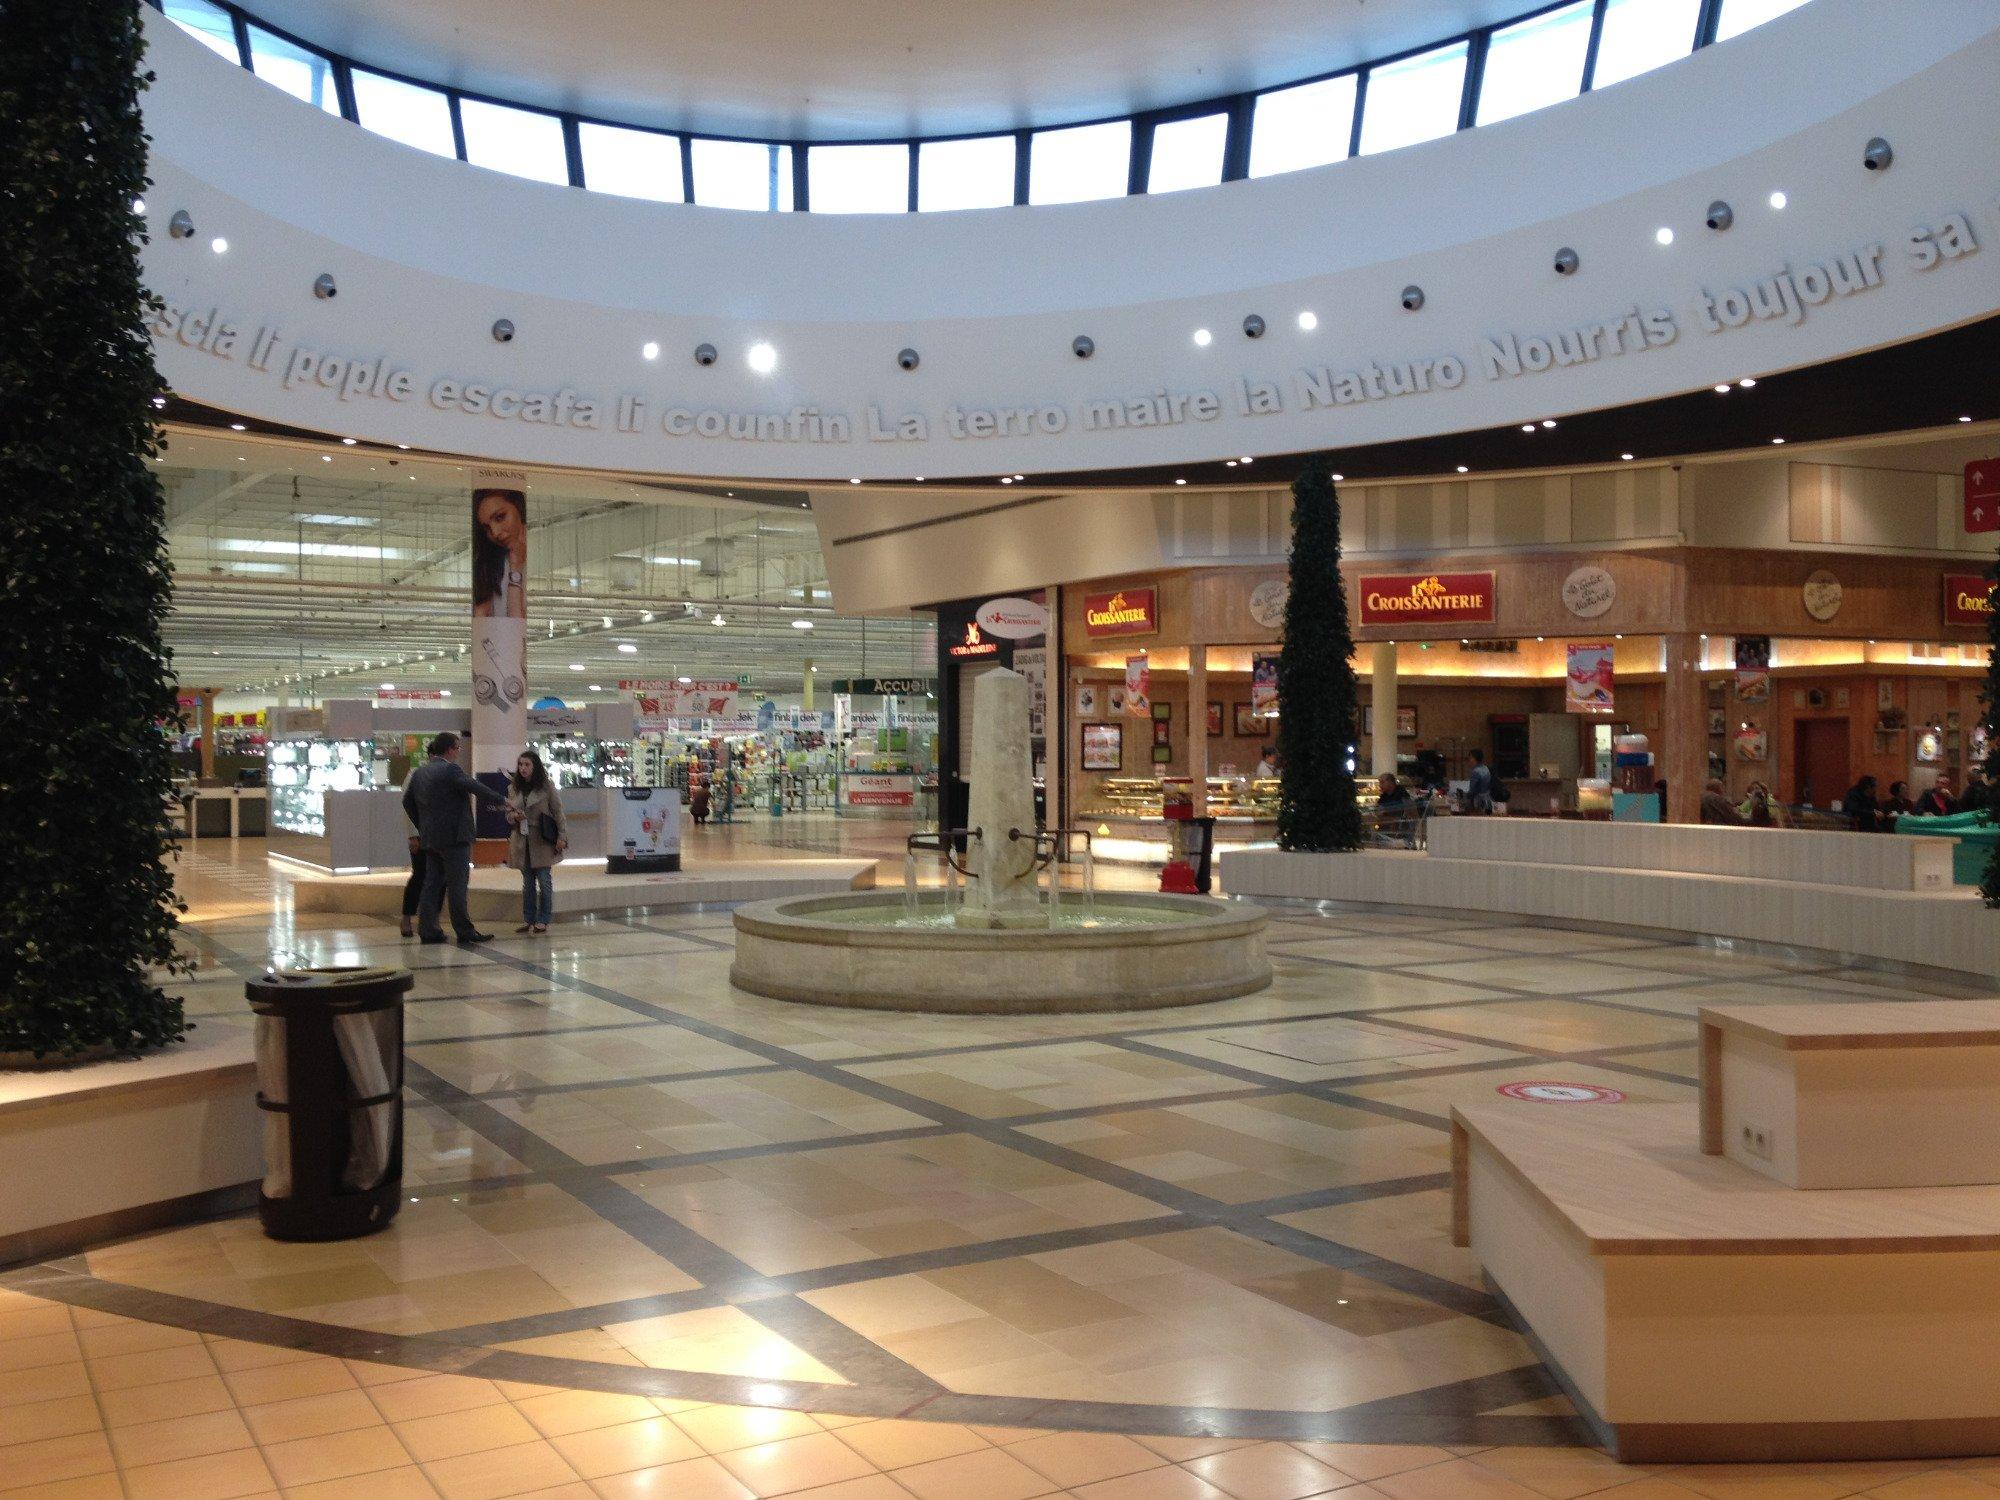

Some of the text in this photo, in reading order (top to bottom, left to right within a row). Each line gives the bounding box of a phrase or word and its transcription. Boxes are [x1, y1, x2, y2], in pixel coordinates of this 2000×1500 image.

[249, 320, 283, 373] li
[282, 346, 415, 403] pople
[428, 378, 601, 431] escafa
[615, 391, 646, 434] li
[662, 405, 849, 443] counfin
[867, 401, 928, 442] La
[943, 404, 1067, 440] terro
[1082, 387, 1222, 432] maire
[1238, 376, 1284, 417] la
[1297, 352, 1465, 411] Naturo
[1480, 305, 1681, 382] Nourris
[1694, 244, 1887, 337] toujour
[1902, 213, 1979, 273] sa
[1367, 592, 1485, 611] CROISSANTERIE
[1087, 607, 1147, 626] CROISSANTERIE
